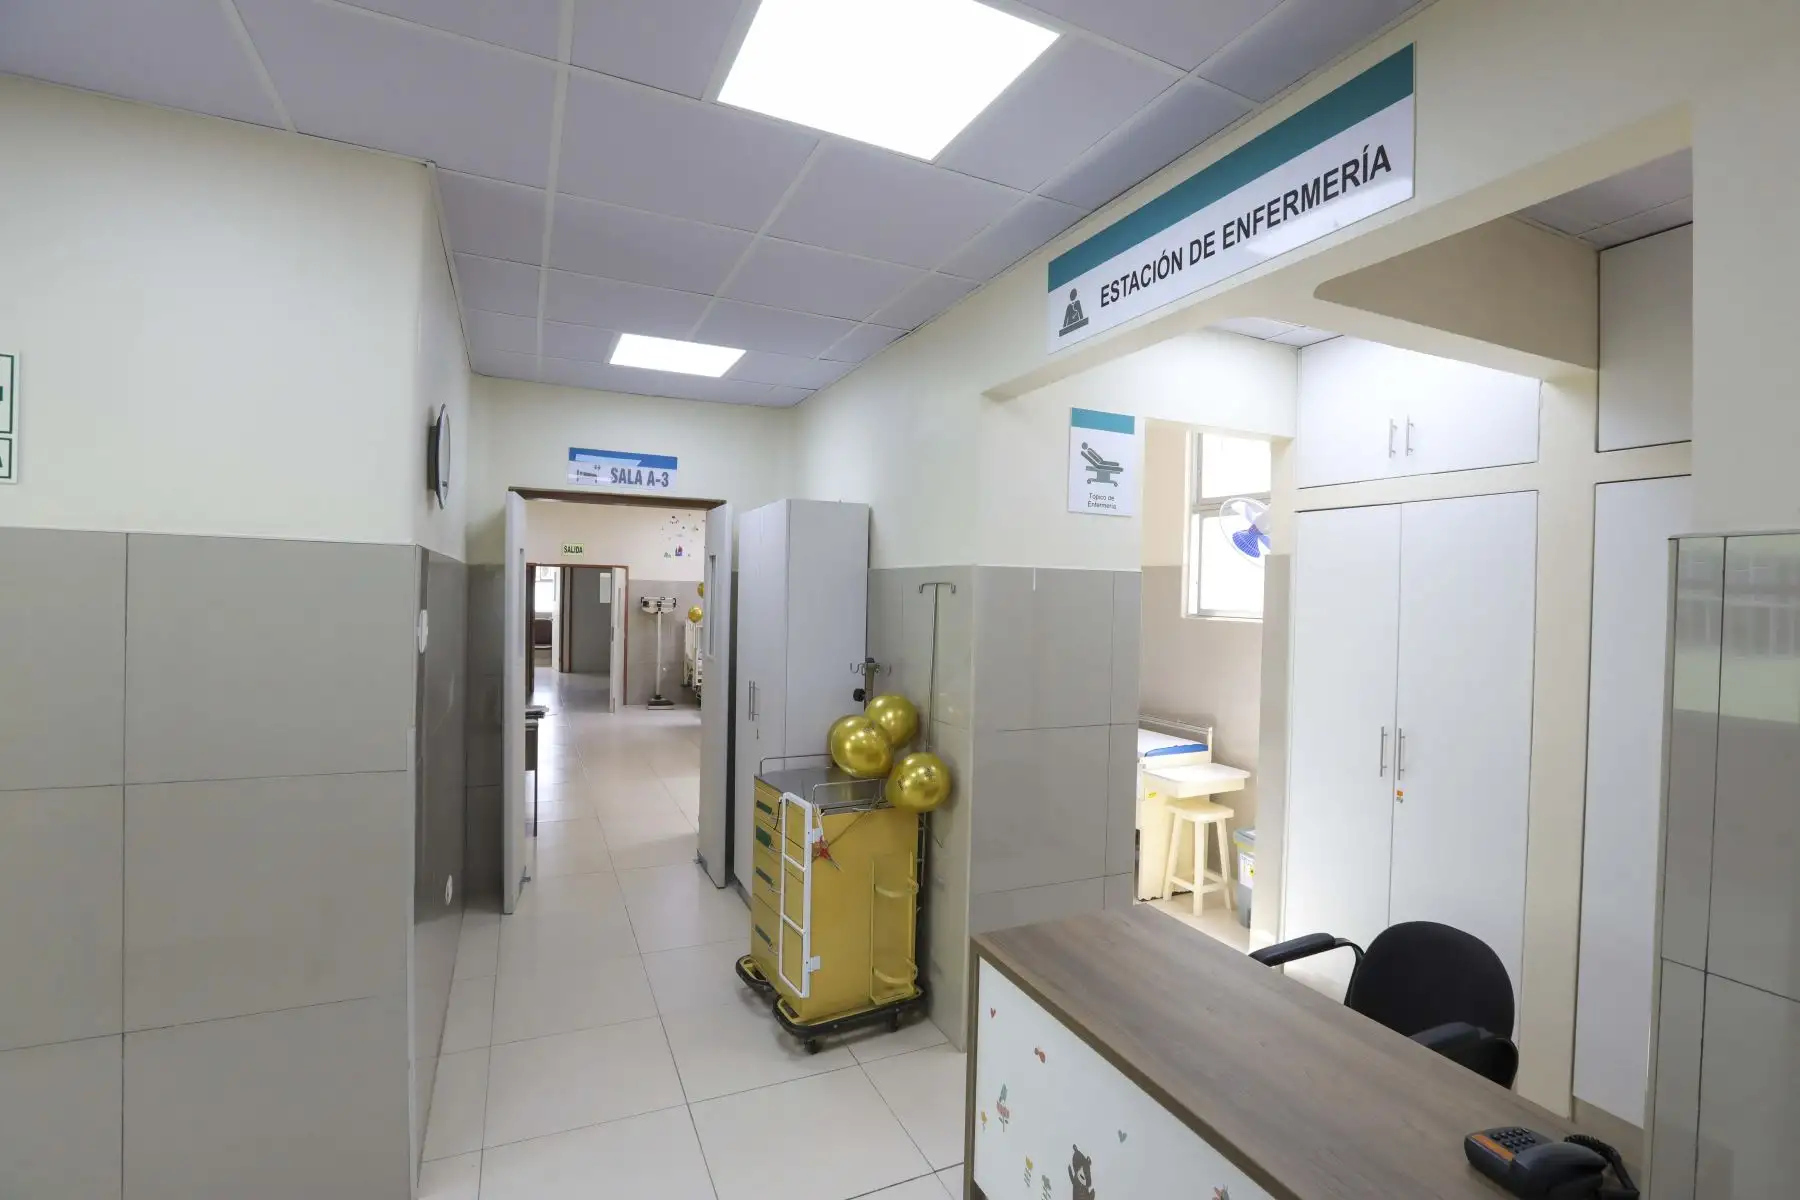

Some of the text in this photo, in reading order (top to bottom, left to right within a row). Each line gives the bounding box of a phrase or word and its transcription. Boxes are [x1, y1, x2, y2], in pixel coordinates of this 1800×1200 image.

[1100, 144, 1392, 307] ESTACIÓN DE ENFERMERÍA
[610, 467, 669, 487] SALA A-3
[563, 545, 583, 554] SALIDA
